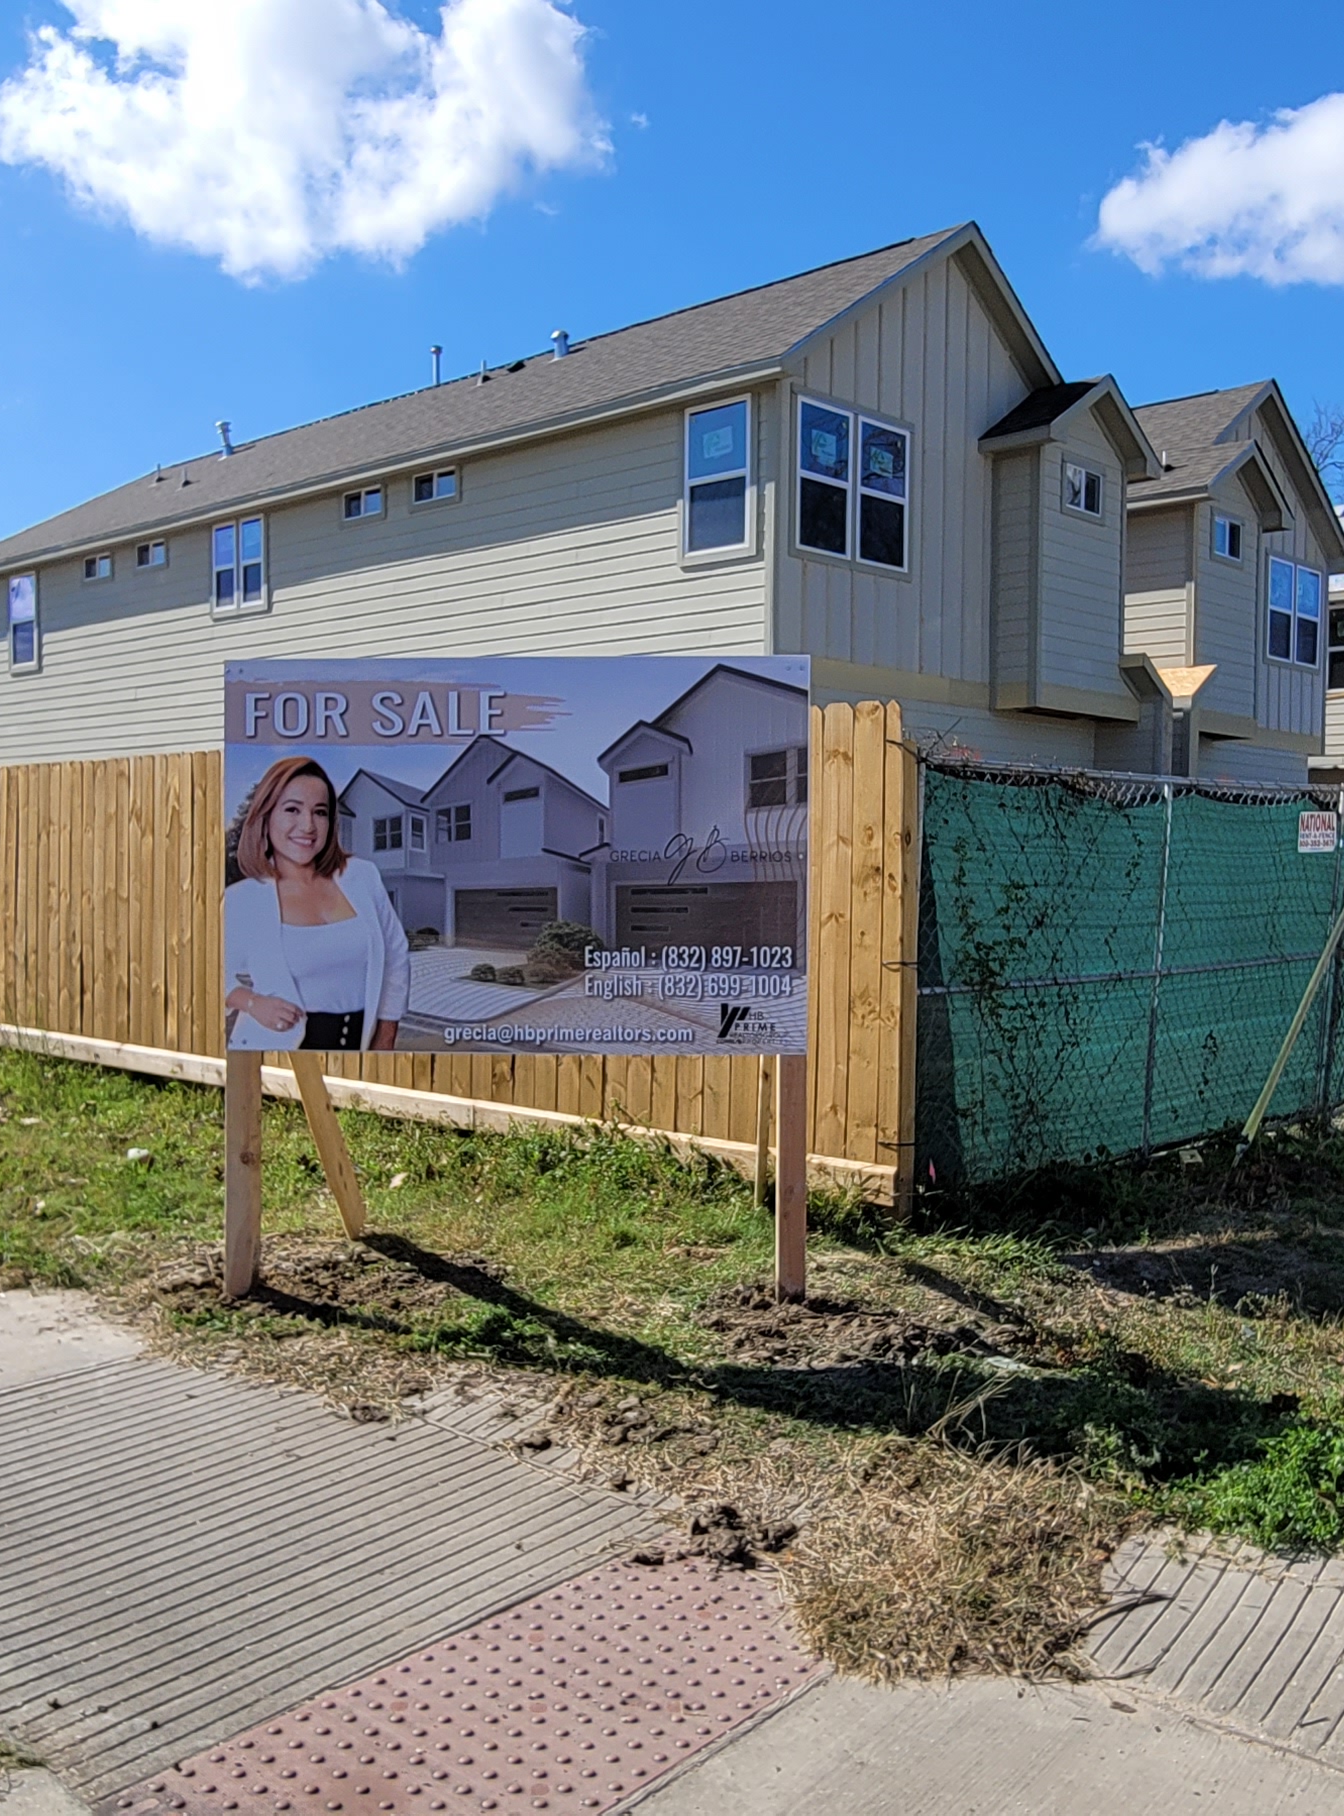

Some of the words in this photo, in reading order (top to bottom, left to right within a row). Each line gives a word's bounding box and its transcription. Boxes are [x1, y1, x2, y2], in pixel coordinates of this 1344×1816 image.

[245, 691, 348, 738] FOR
[371, 691, 506, 737] SALE
[1300, 813, 1335, 832] NATIONAL
[609, 851, 662, 863] GRECIA
[731, 852, 792, 863] BERRIOS
[584, 946, 646, 971] Español
[661, 946, 707, 971] (832)
[711, 946, 793, 968] 897-1023
[584, 975, 643, 1000] English
[658, 975, 703, 1000] (832)
[708, 975, 792, 997] 699-1004
[444, 1024, 694, 1046] grecia@hbprimerealtors.com
[734, 1023, 776, 1032] PRIME
